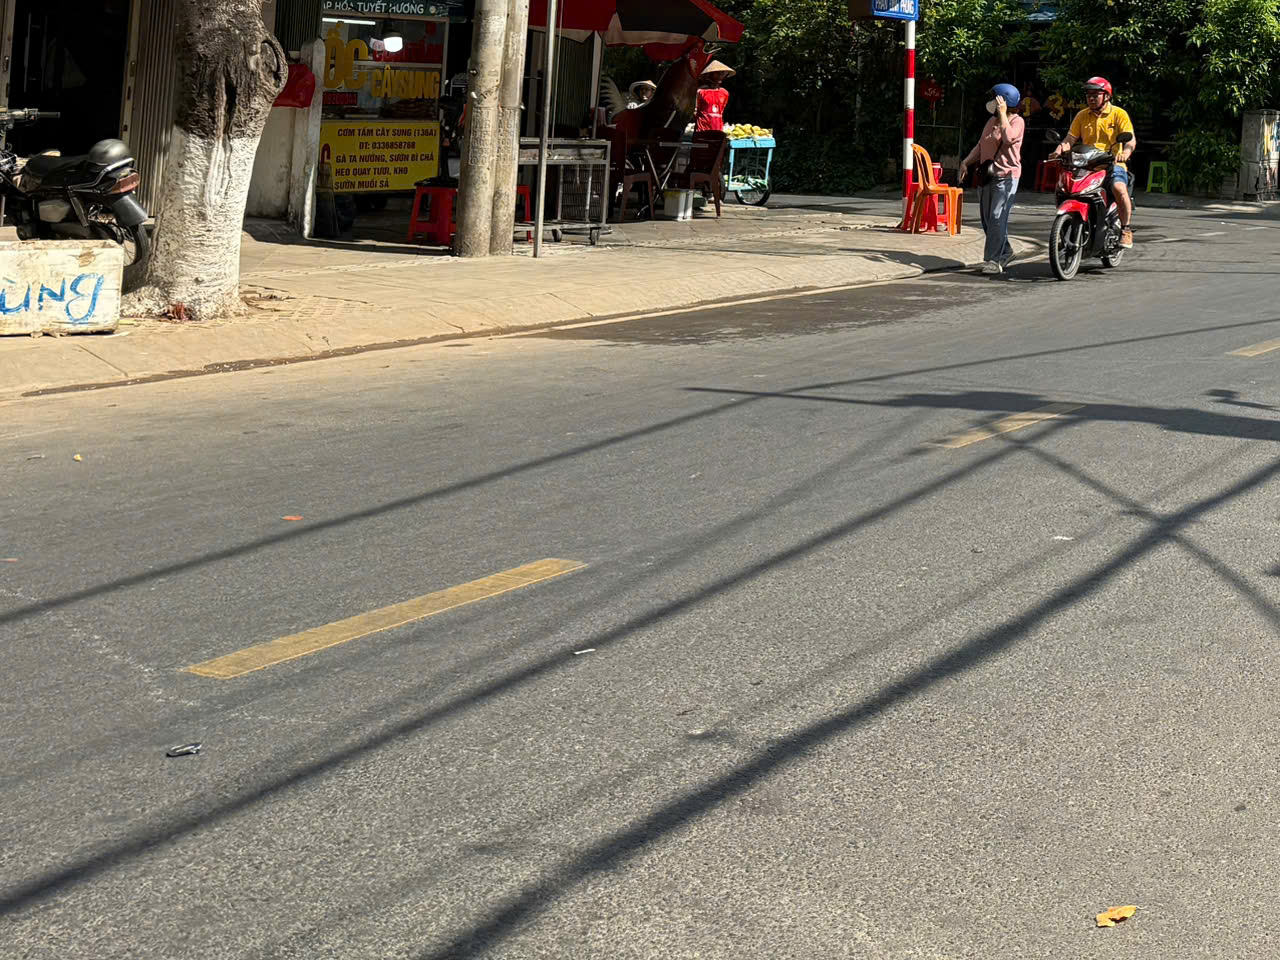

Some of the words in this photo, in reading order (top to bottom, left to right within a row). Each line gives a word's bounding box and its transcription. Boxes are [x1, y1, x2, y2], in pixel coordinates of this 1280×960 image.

[338, 128, 355, 137] CƠM
[357, 127, 374, 137] TẤM
[375, 127, 390, 137] CÂY
[392, 128, 411, 137] SUNG
[335, 168, 350, 177] HEO
[352, 168, 371, 177] QUAY
[393, 166, 408, 175] KHO
